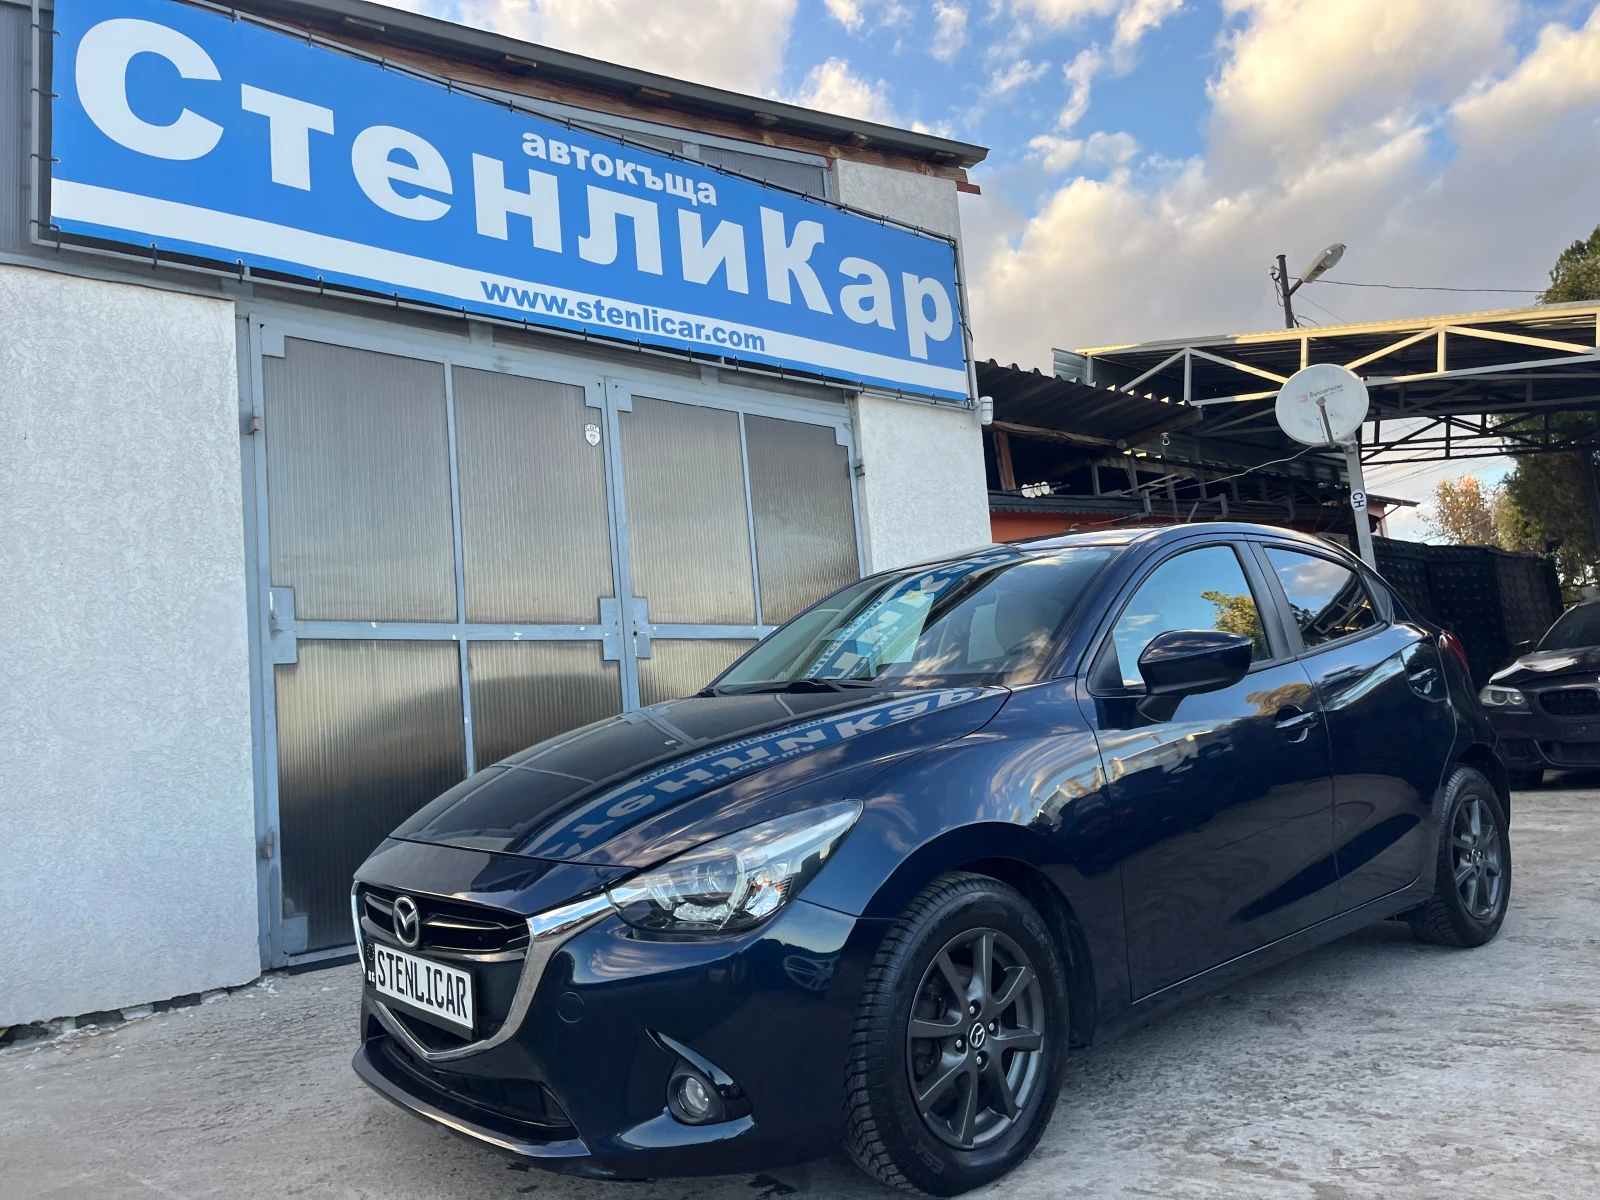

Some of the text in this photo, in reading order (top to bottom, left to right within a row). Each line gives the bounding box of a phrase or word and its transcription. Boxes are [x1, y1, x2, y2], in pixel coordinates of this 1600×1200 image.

[76, 18, 953, 360] СтенлиКар
[522, 131, 718, 207] автокъща
[481, 281, 766, 352] www.stenlicar.com
[377, 950, 468, 1019] STENLICAR
